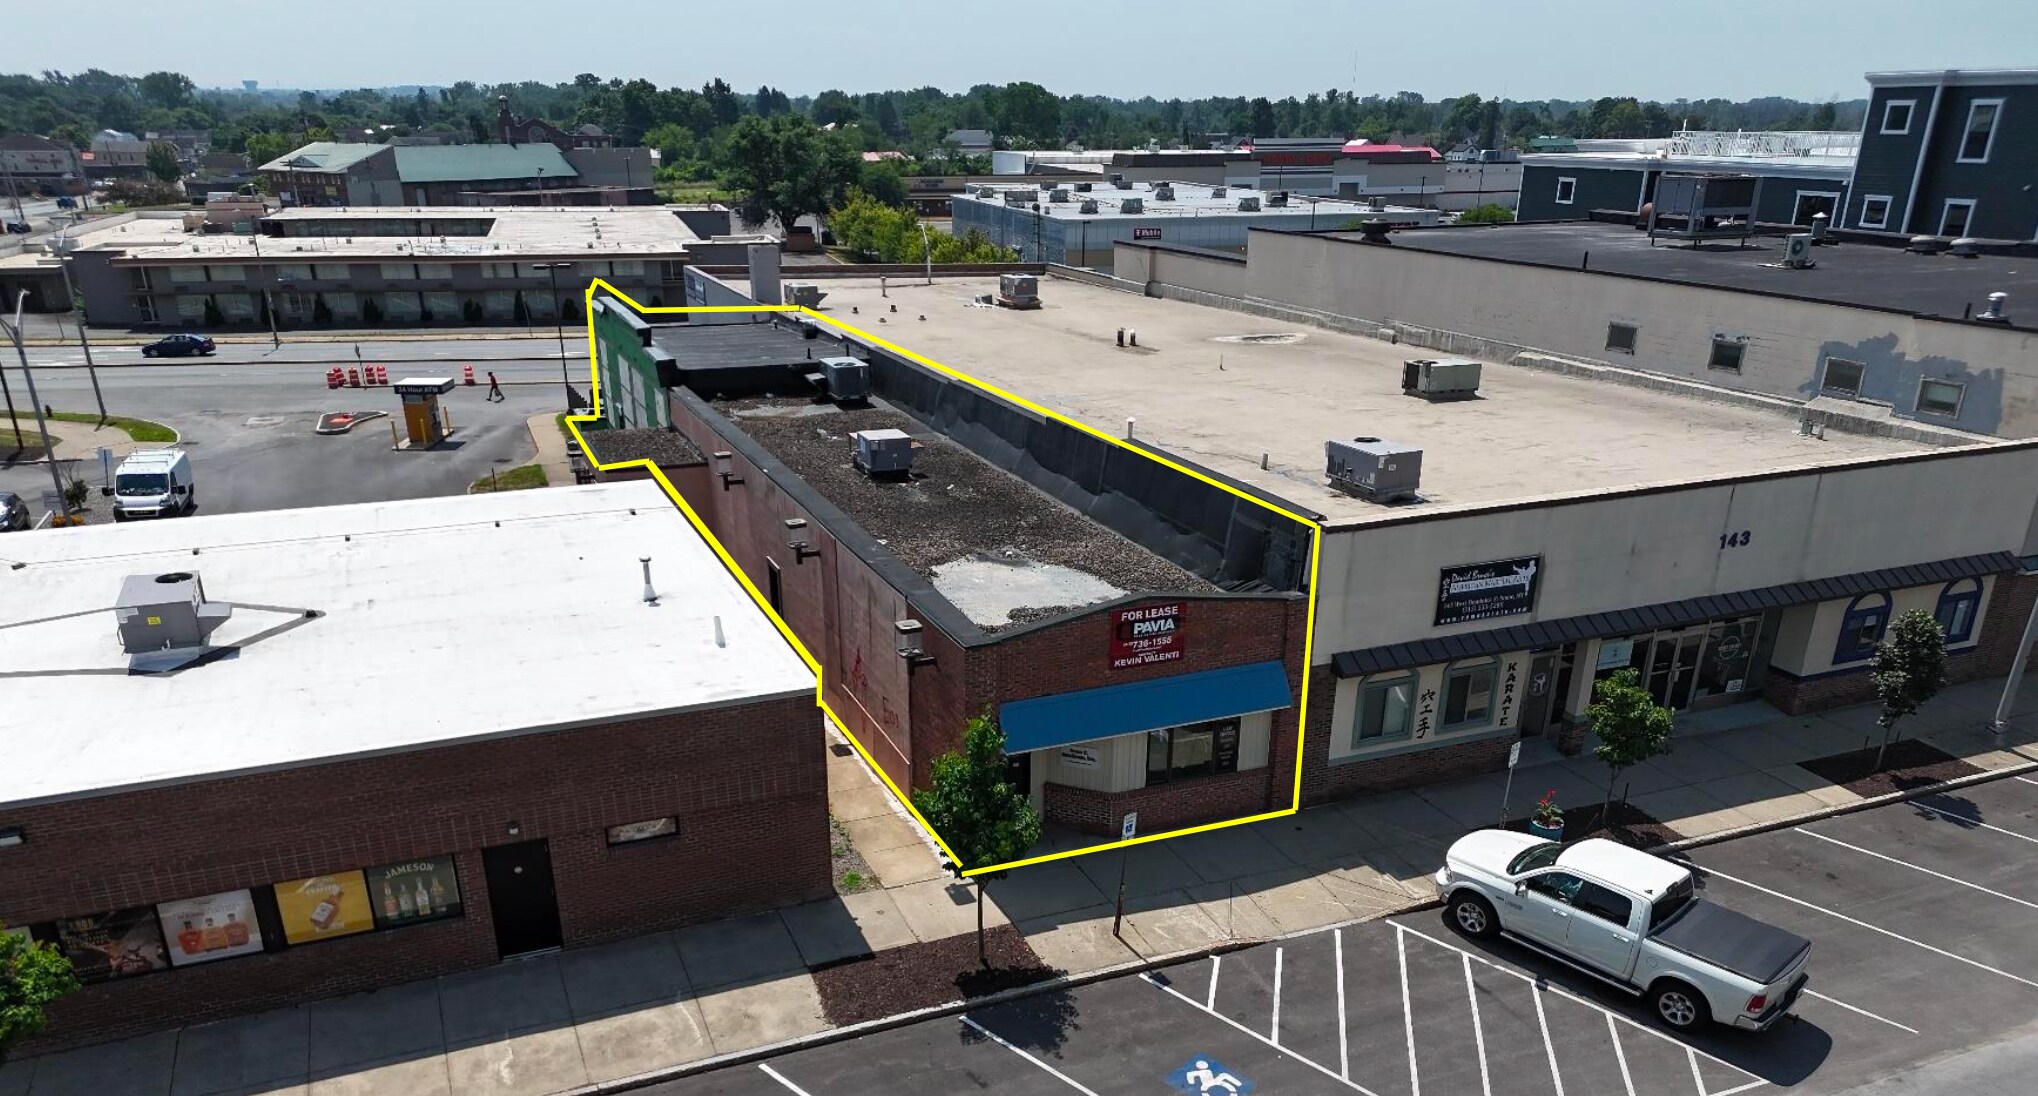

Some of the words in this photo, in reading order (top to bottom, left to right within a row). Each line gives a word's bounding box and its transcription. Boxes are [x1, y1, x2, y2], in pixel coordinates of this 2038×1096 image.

[1720, 530, 1751, 550] 143
[1121, 611, 1143, 621] FOR
[1145, 606, 1178, 619] LEASE
[1133, 618, 1175, 635] PAVIA
[1114, 656, 1142, 668] KEVIN
[1144, 651, 1179, 663] VALENTI
[1499, 662, 1517, 727] KARATE
[384, 862, 433, 879] JAMESON
